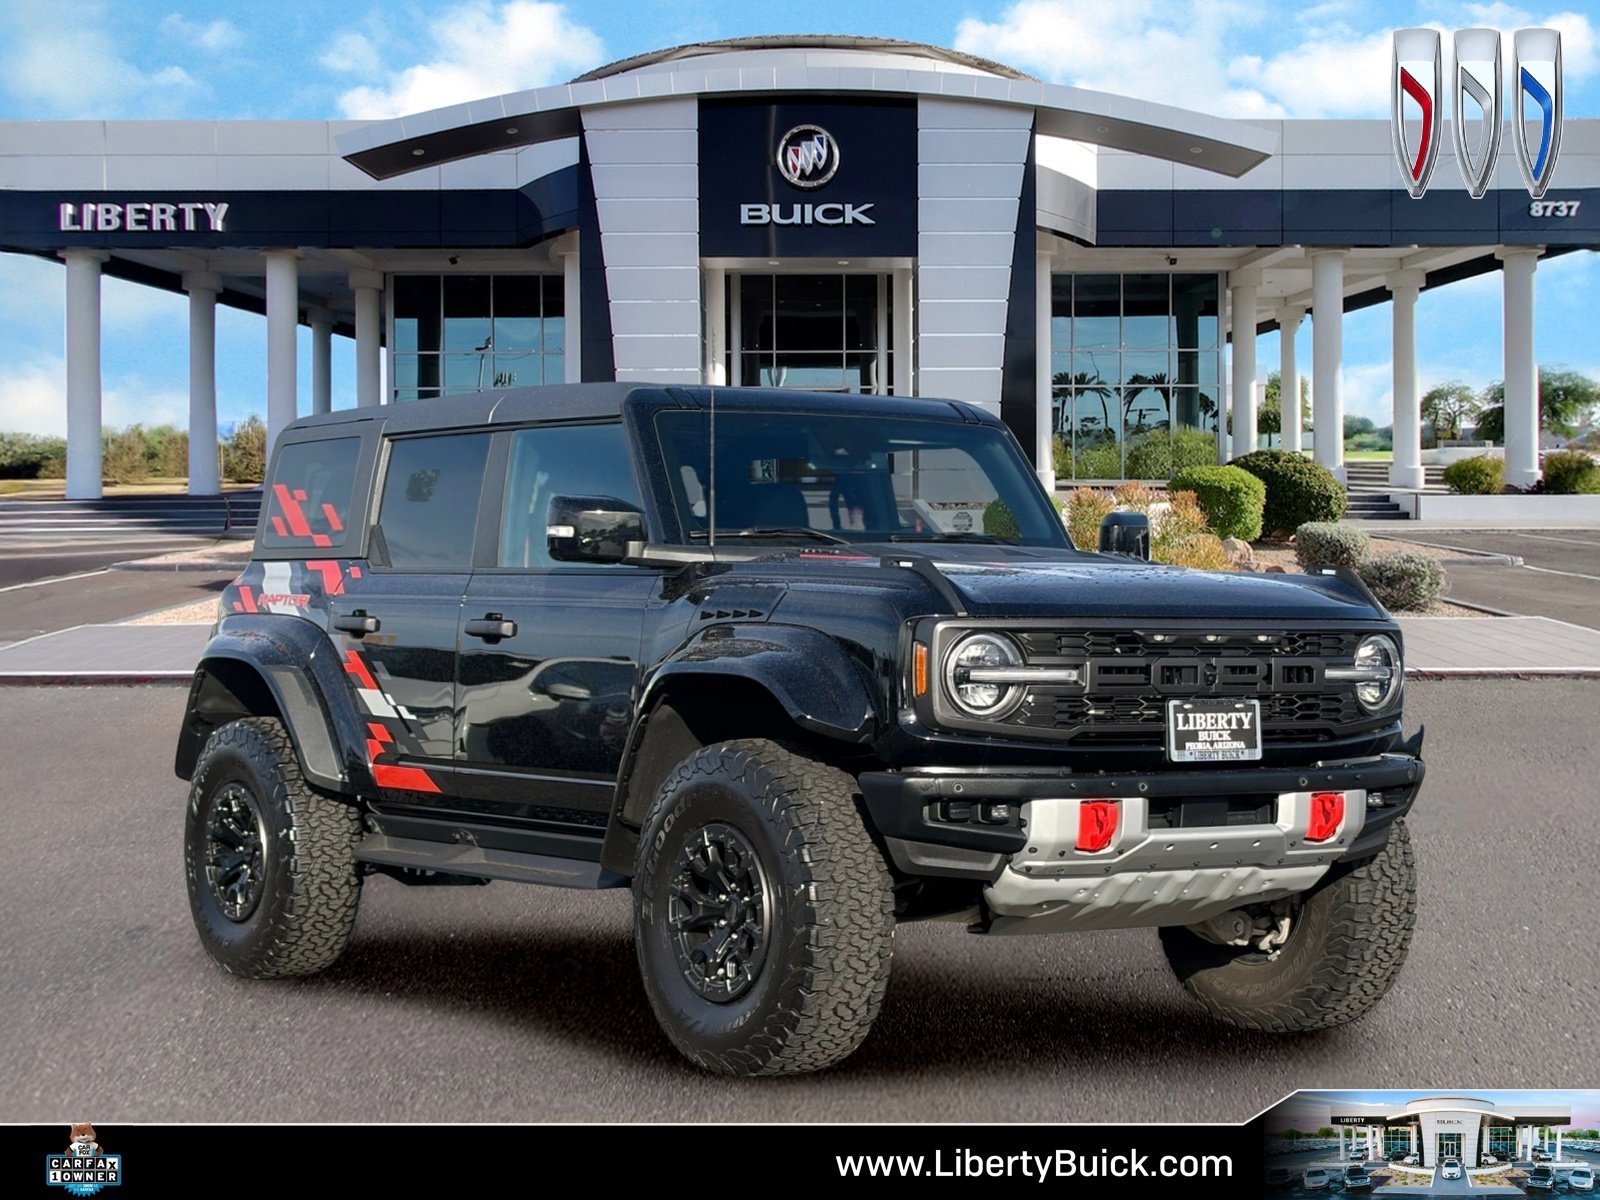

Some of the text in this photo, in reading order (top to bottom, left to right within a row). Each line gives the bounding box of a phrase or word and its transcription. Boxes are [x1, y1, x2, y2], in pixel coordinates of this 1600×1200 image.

[59, 202, 229, 232] LIBERTY
[740, 203, 876, 225] BUICK
[1529, 201, 1580, 217] 8737
[257, 593, 311, 612] RAPTOR
[1084, 657, 1325, 694] FORD
[1176, 712, 1253, 730] LIBERTY
[1198, 730, 1231, 741] BUICK
[1212, 741, 1246, 750] ARIZONA
[1194, 750, 1241, 760] LIBERTY BUICK
